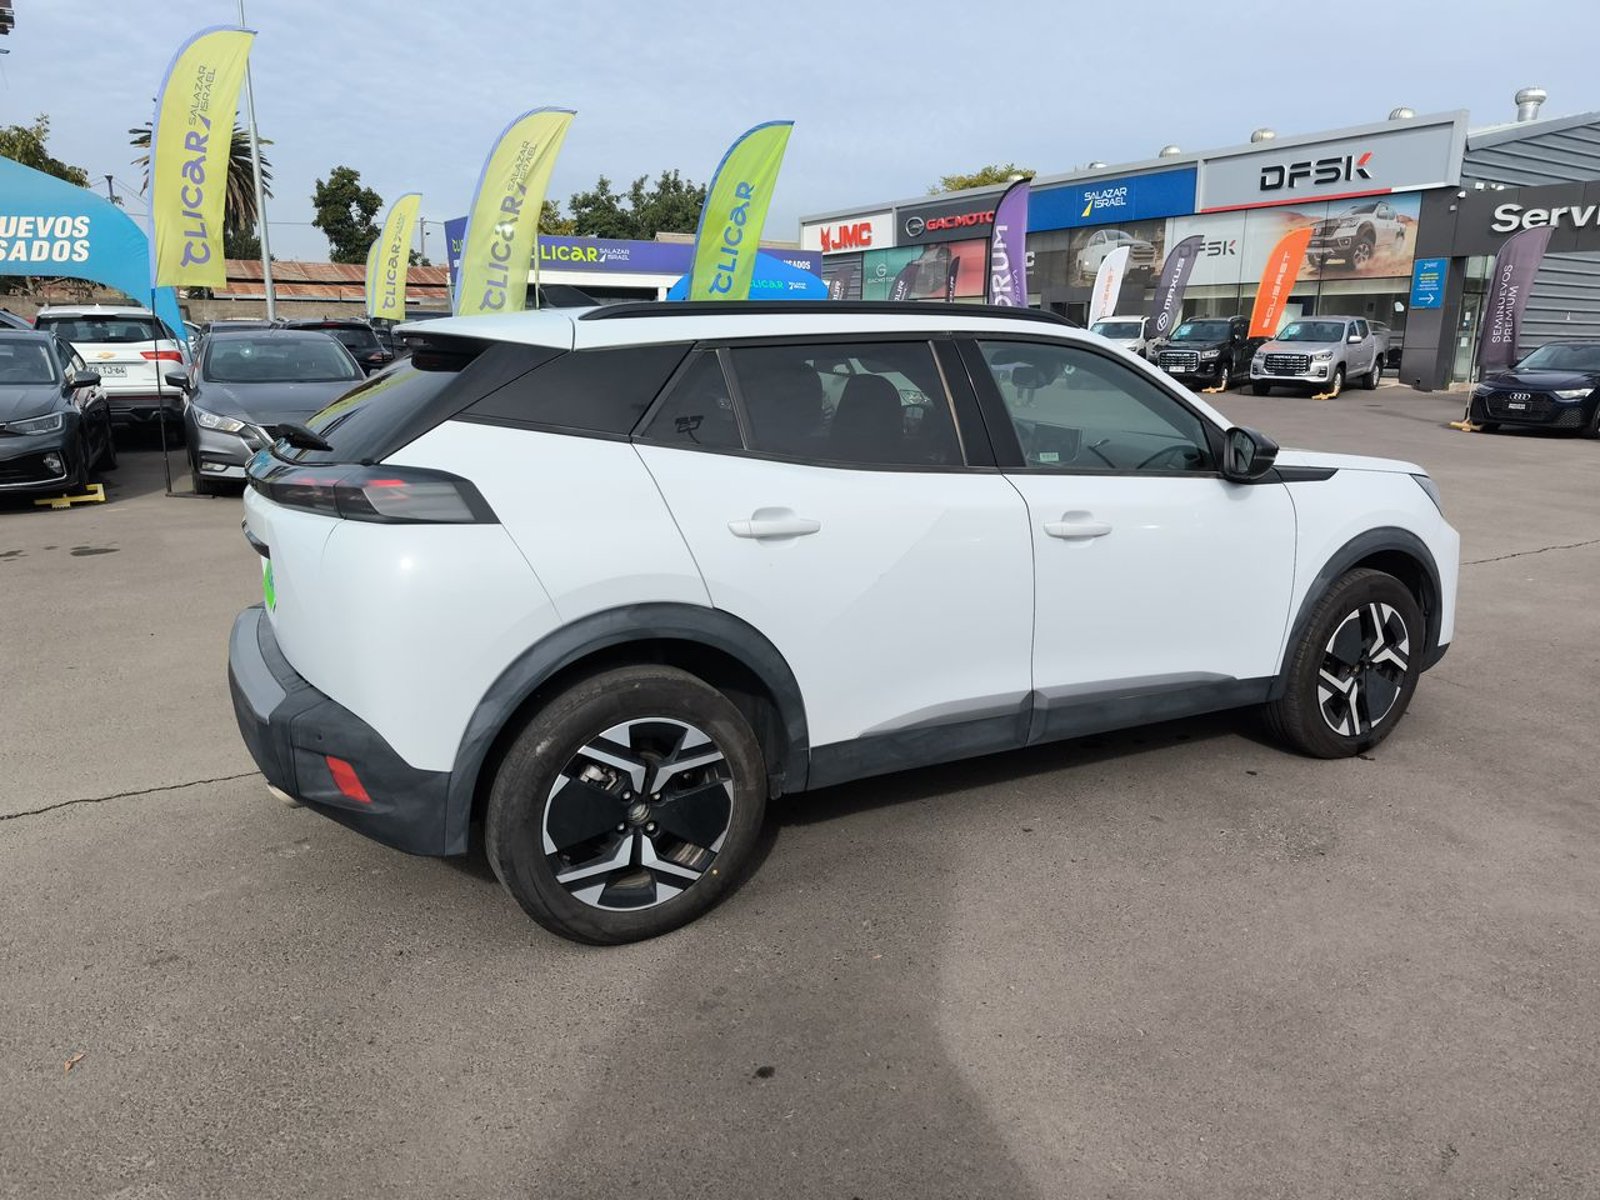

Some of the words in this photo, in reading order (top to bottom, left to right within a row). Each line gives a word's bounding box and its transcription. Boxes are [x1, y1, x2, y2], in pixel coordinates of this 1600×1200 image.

[189, 65, 206, 126] SALAZAR
[199, 69, 216, 112] ISRAEL
[507, 140, 530, 191] SALAZAR
[1260, 152, 1373, 191] DFSK
[1084, 187, 1127, 201] SALAZAR
[1094, 197, 1126, 208] ISRAEL
[831, 223, 871, 249] JMC
[1164, 257, 1185, 310] MAXUS
[1491, 264, 1514, 343] SEMINUEVOS
[1503, 285, 1520, 342] PREMIUM
